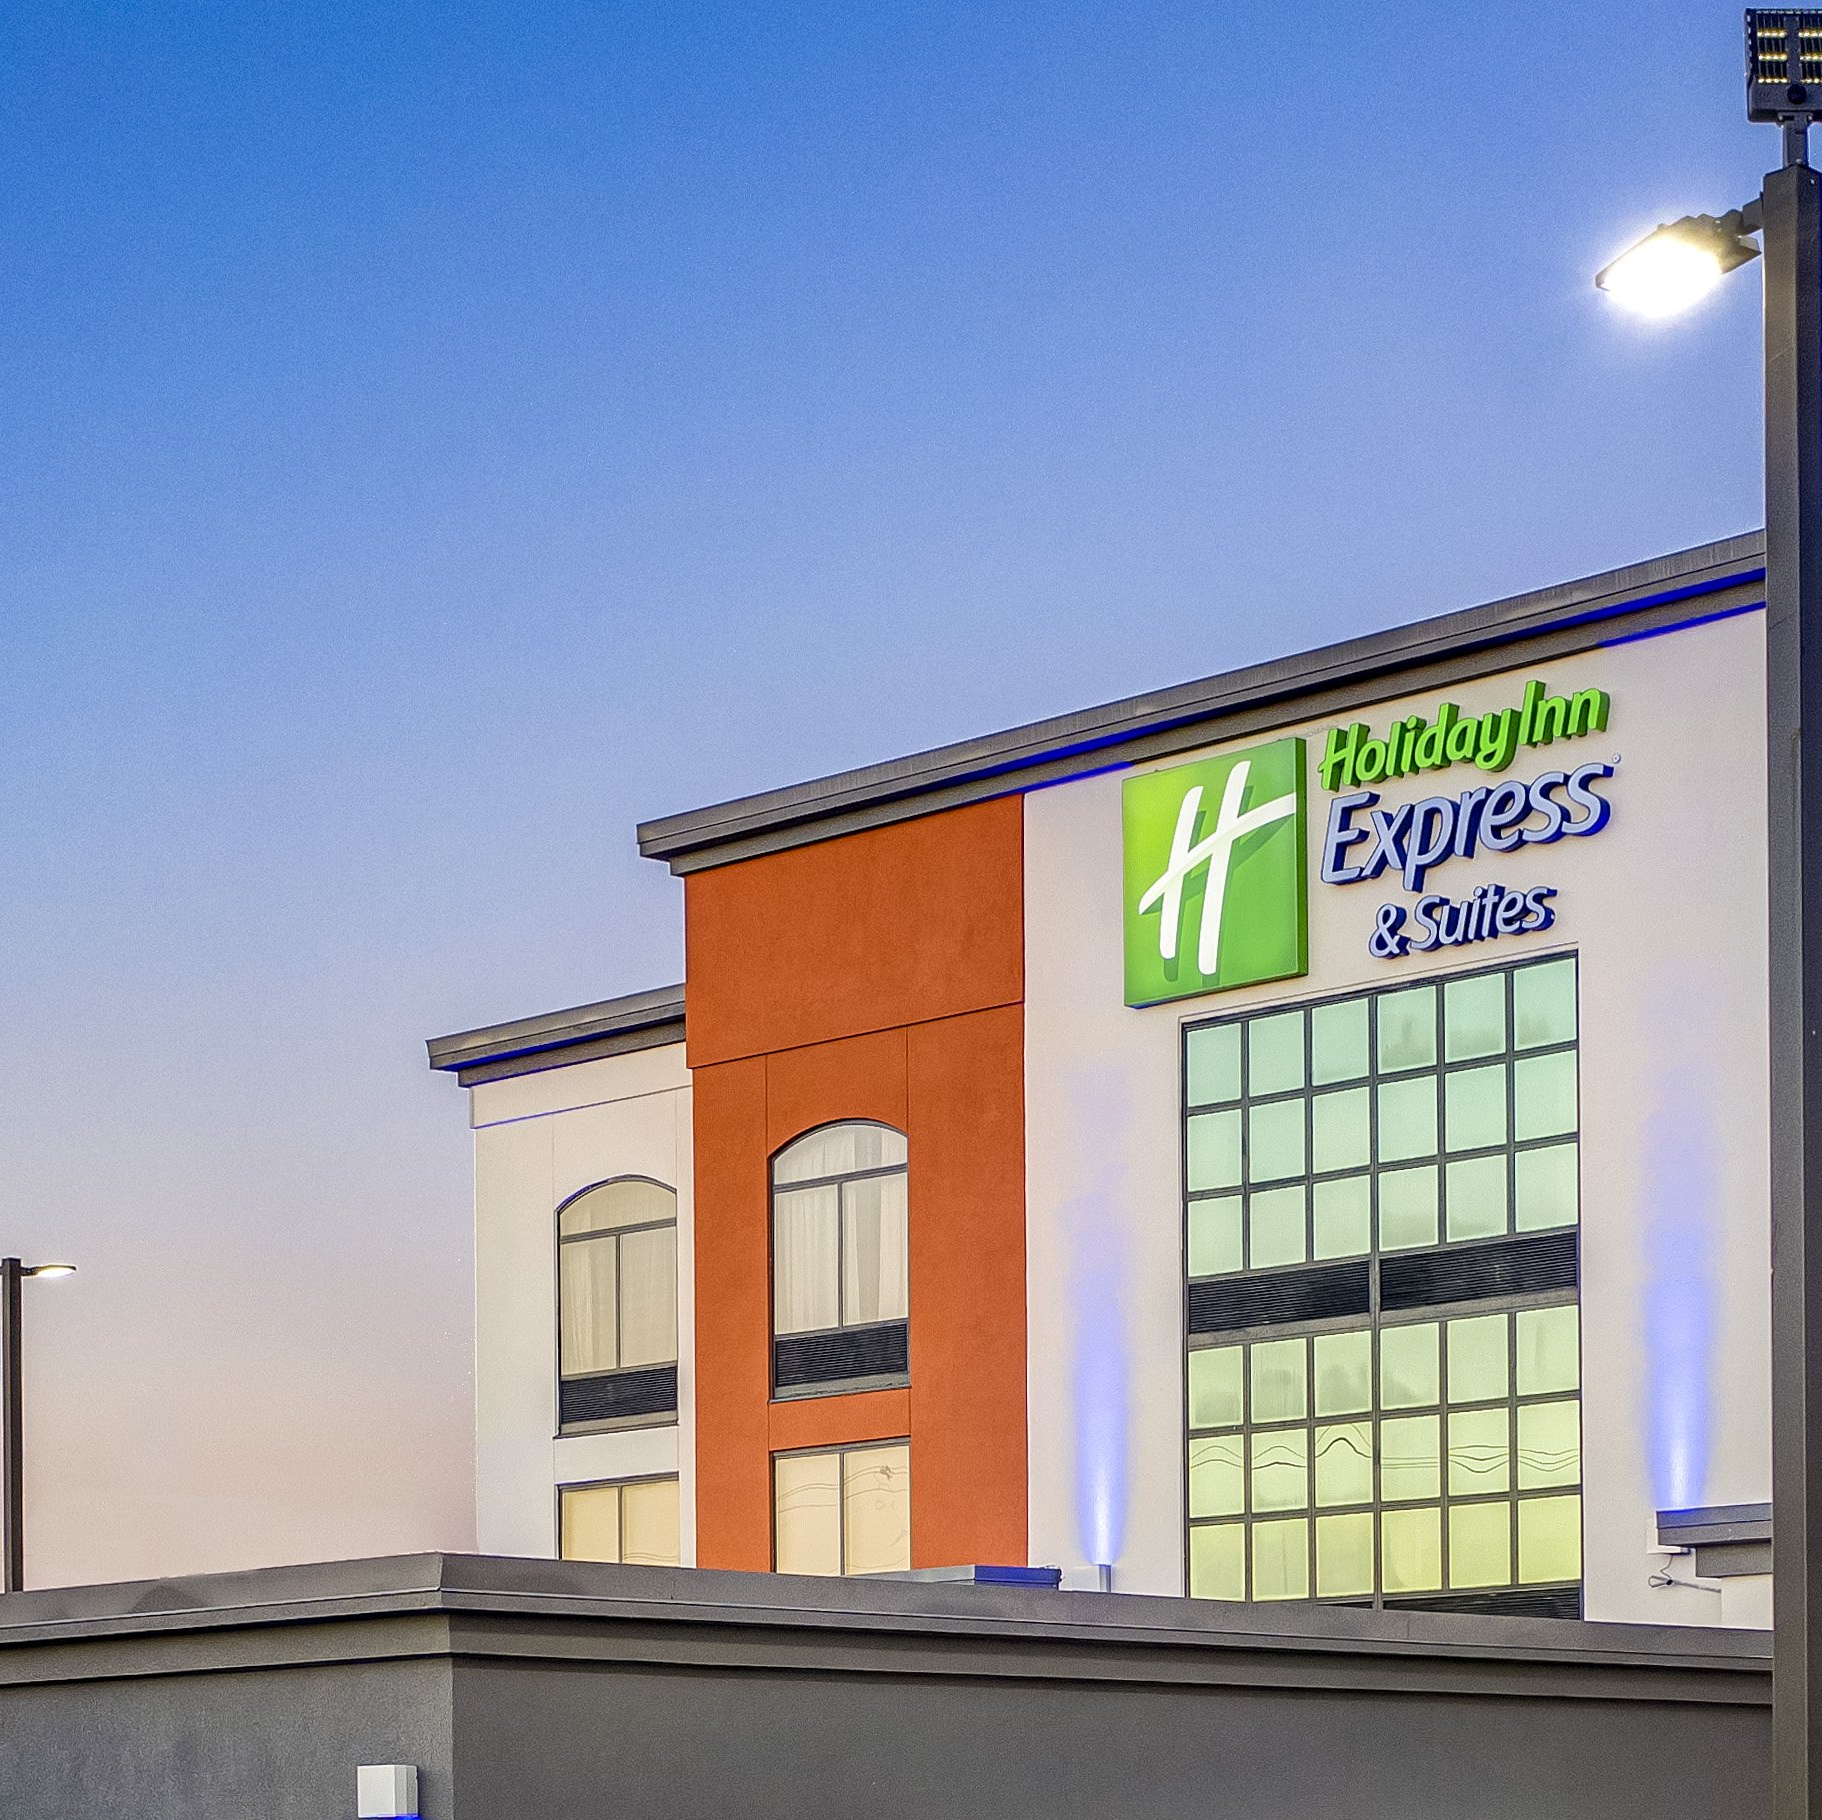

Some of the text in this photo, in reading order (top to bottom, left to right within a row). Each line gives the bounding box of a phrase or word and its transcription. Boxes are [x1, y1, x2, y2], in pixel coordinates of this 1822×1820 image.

[1318, 679, 1611, 793] Holiday Inn
[1321, 761, 1616, 893] Express
[1368, 883, 1559, 959] & Suites
